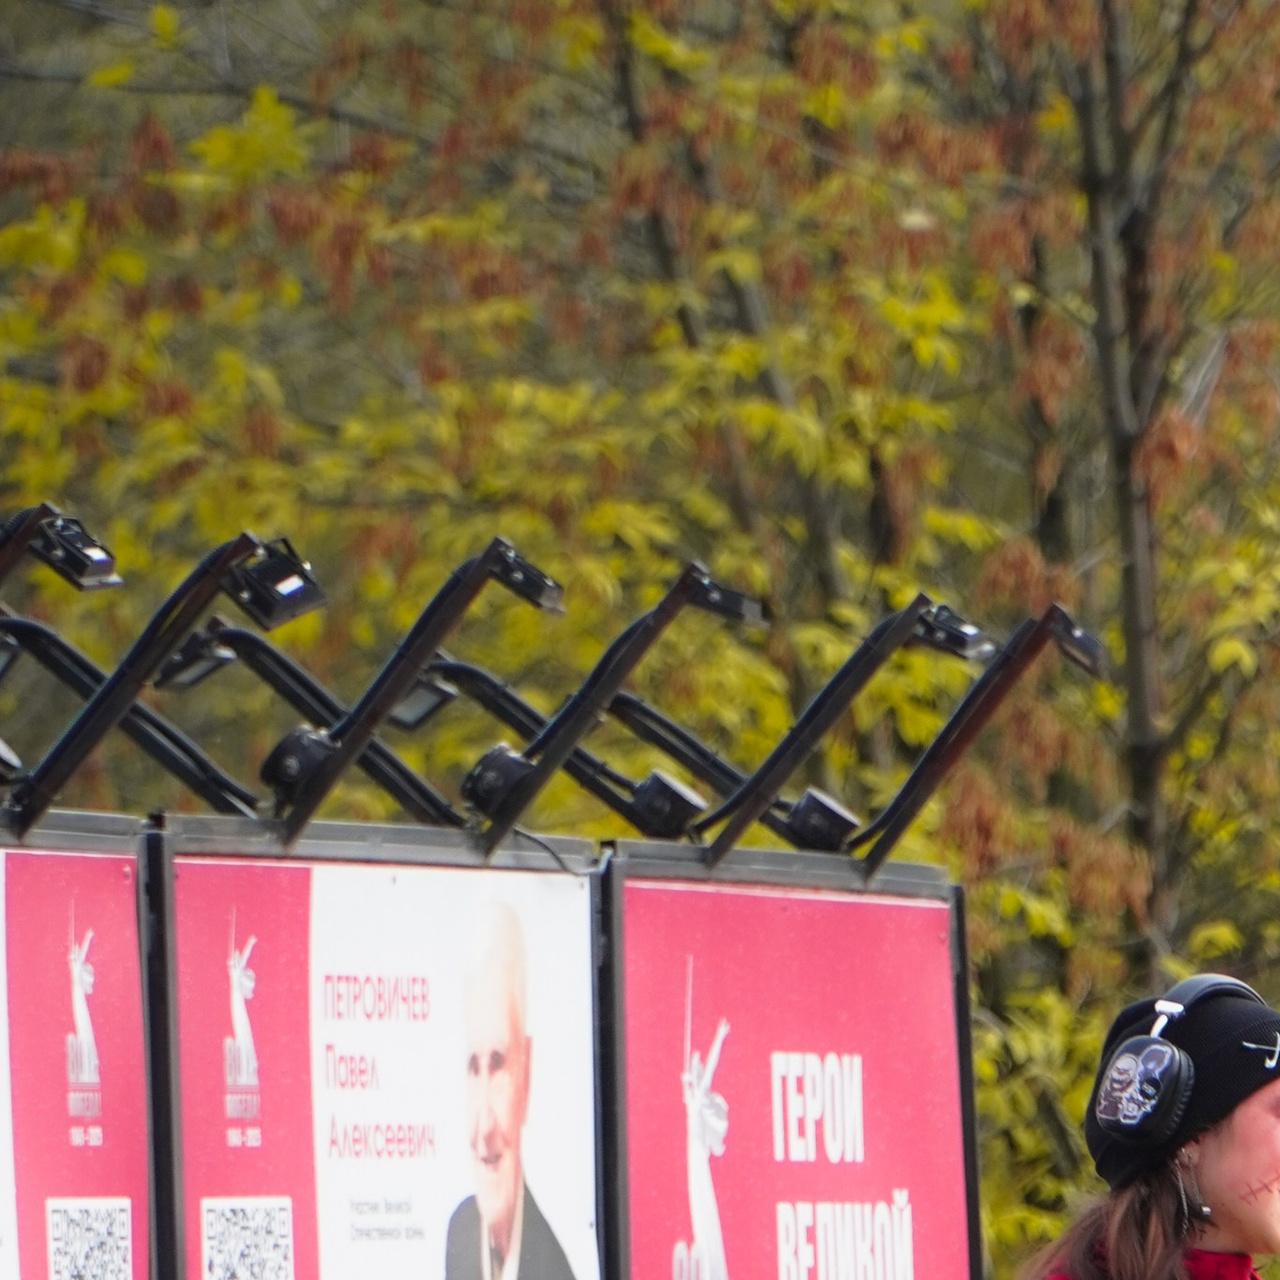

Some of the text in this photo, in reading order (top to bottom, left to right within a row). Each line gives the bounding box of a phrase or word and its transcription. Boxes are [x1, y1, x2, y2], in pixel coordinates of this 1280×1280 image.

[324, 975, 431, 1021] ПЕТРОВИЧЕВ
[325, 1043, 381, 1090] Павел
[770, 1051, 864, 1164] ГЕРОИ
[328, 1113, 437, 1159] Алексеевич
